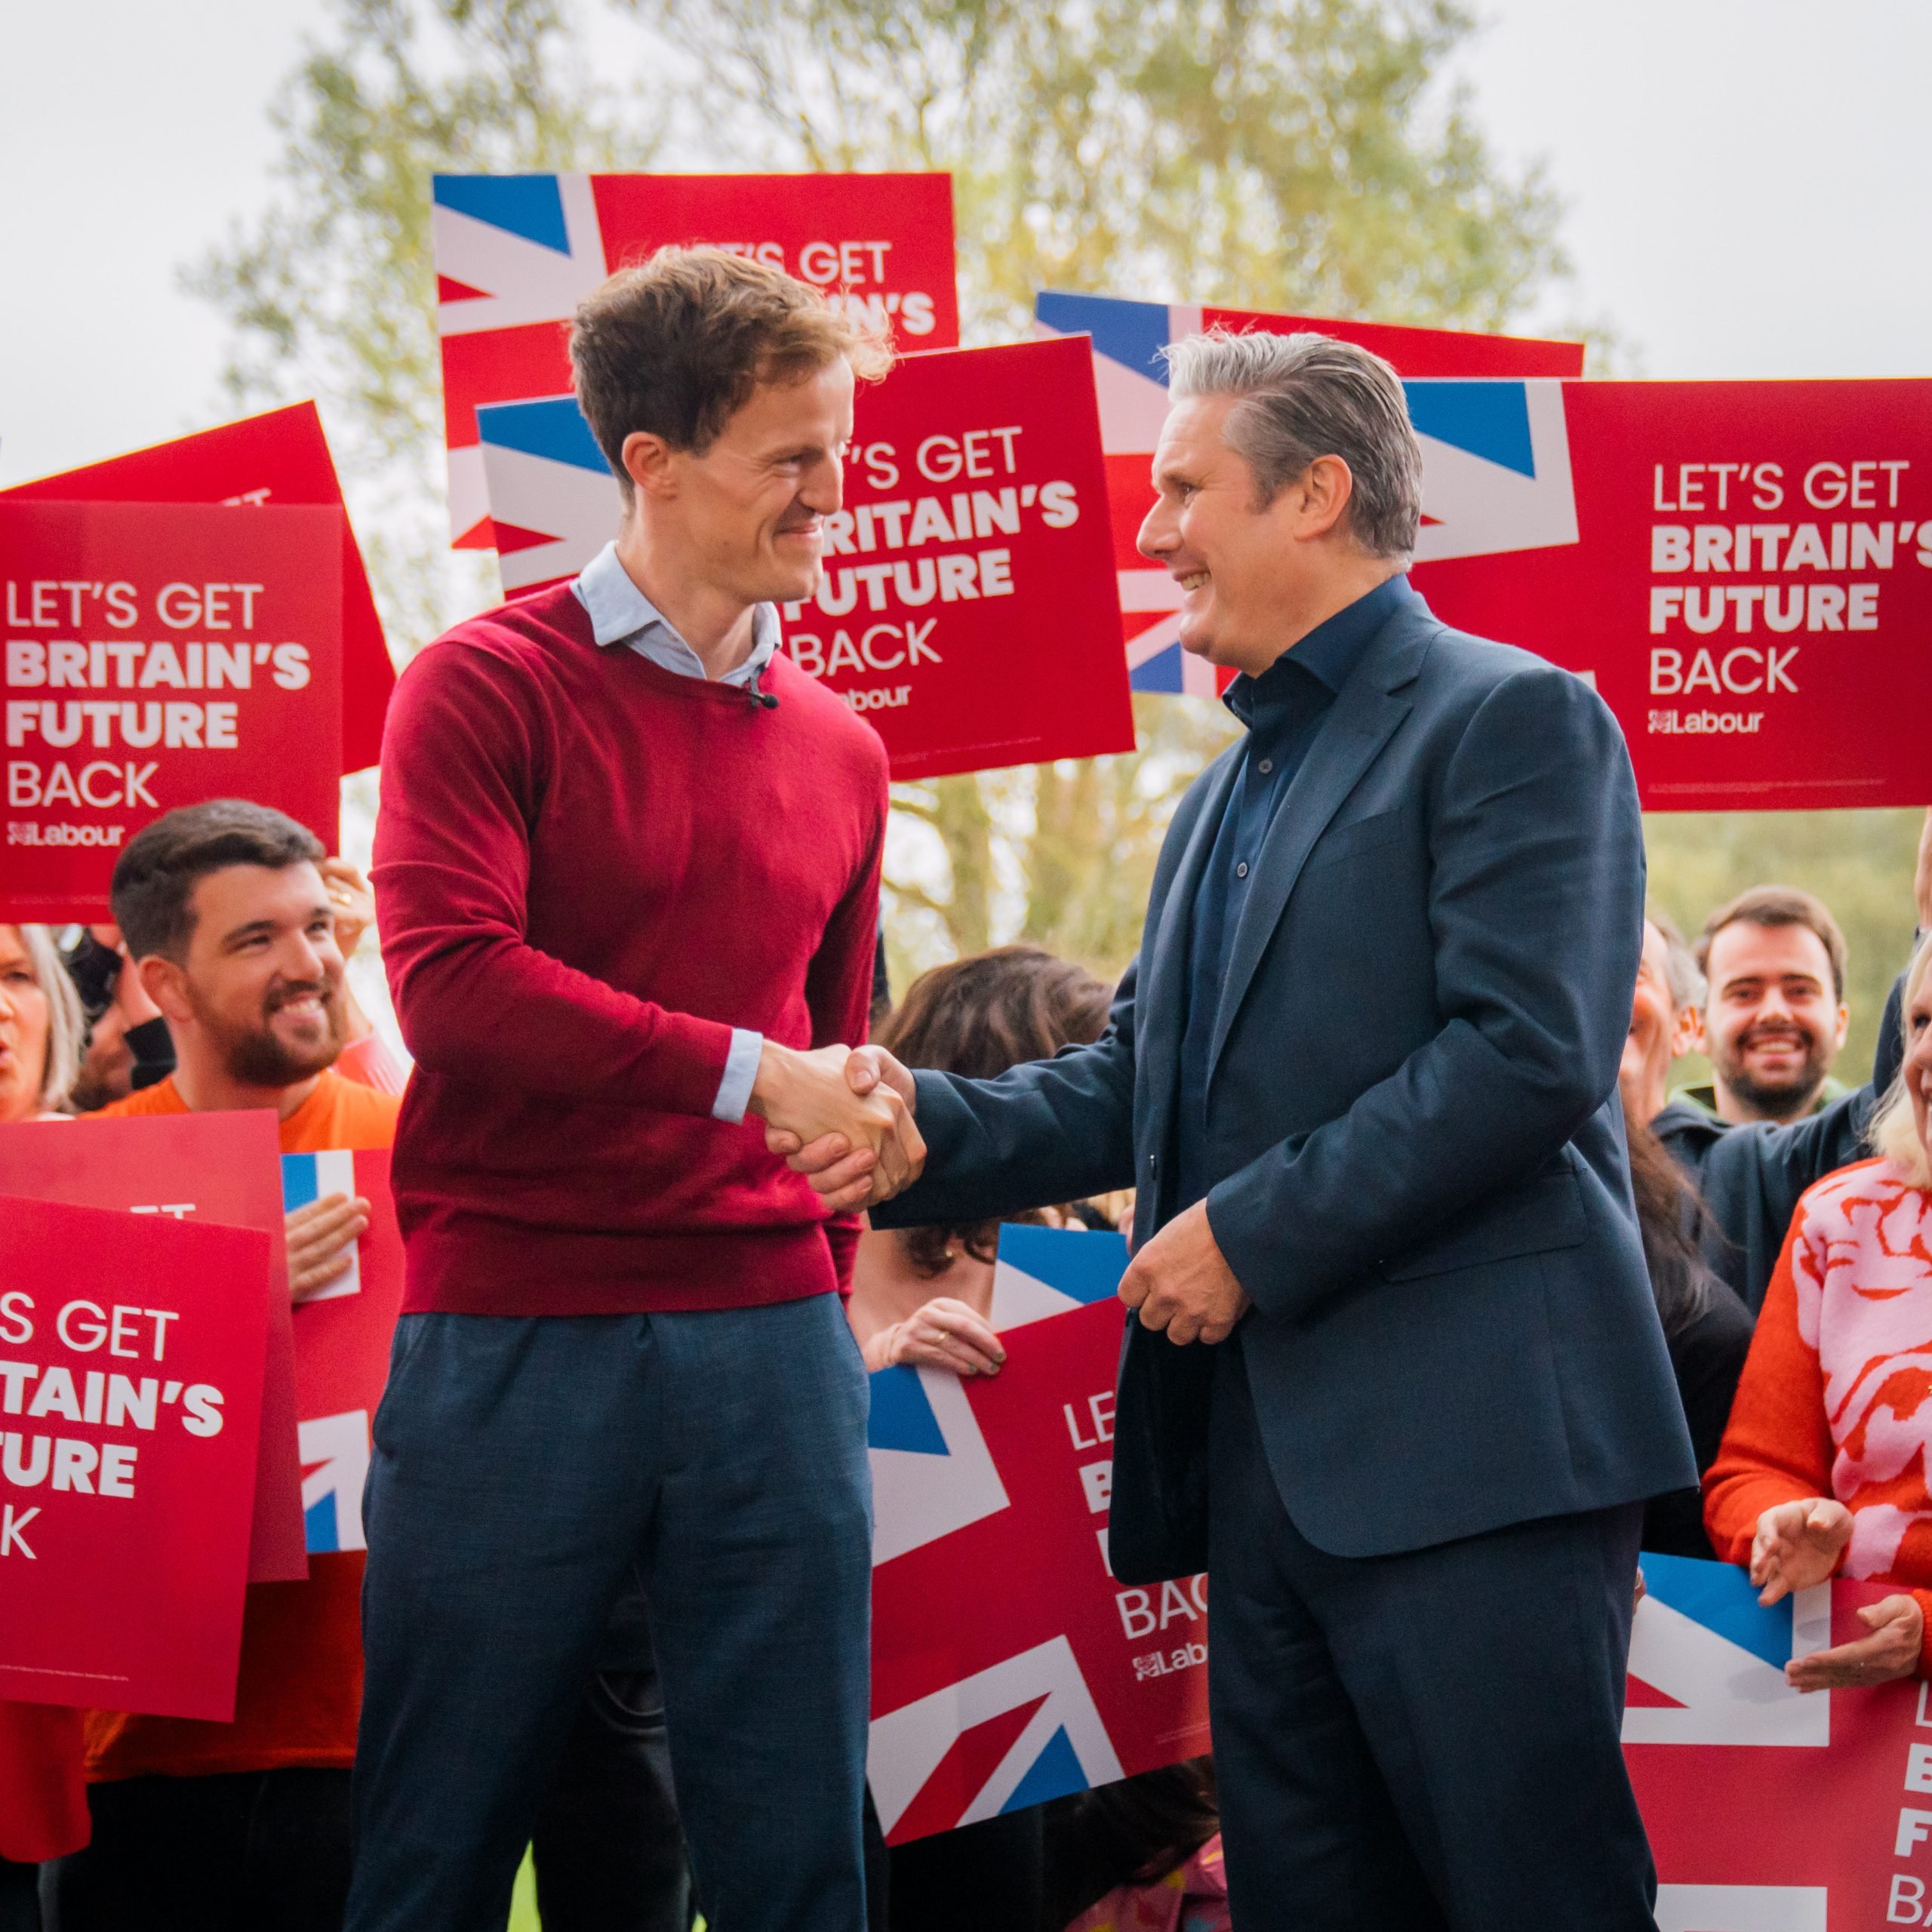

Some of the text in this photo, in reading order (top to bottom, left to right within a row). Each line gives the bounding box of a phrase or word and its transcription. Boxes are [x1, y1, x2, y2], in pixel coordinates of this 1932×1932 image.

[798, 241, 892, 284] GET
[916, 426, 1023, 482] GET
[1654, 460, 1910, 512] LET'S GET
[821, 480, 1079, 557] RITAIN'S
[7, 580, 264, 629] LET'S GET
[1649, 583, 1879, 634] FUTURE
[7, 641, 311, 691] BRITAIN'S
[789, 617, 942, 678] BACK
[1650, 647, 1799, 695] BACK
[836, 685, 912, 712] bour
[1671, 709, 1764, 734] Labour
[7, 700, 238, 749] FUTURE
[8, 760, 159, 808] BACK
[32, 820, 125, 847] Labour
[57, 1300, 180, 1361] GET
[0, 1360, 224, 1438] TAIN'S
[0, 1432, 138, 1499] URE
[1115, 1574, 1208, 1640] BA
[1157, 1642, 1208, 1675] Lab
